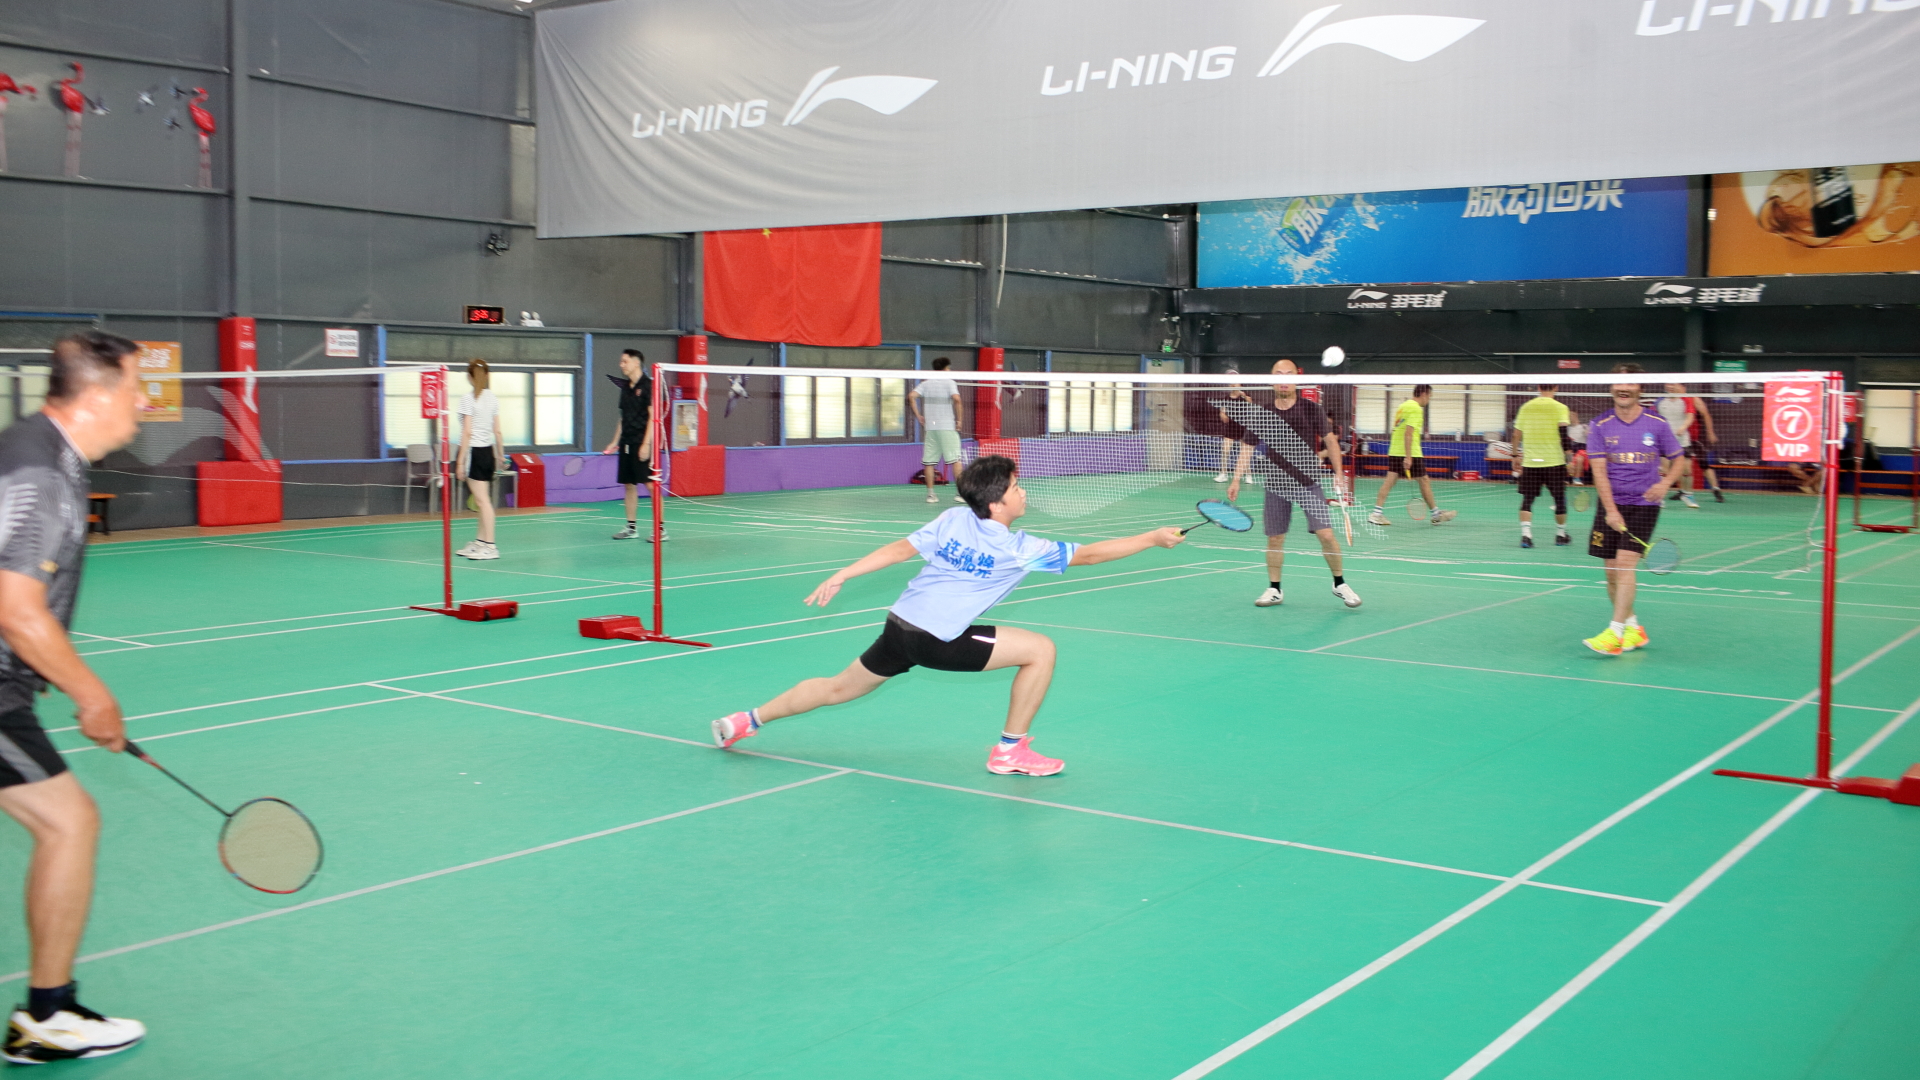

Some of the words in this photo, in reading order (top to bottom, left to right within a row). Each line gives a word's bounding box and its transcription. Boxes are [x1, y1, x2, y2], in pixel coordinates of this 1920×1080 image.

[1040, 45, 1237, 96] LI-NING
[631, 99, 769, 139] LI-NING
[1783, 410, 1803, 434] 7
[1774, 442, 1810, 457] VIP
